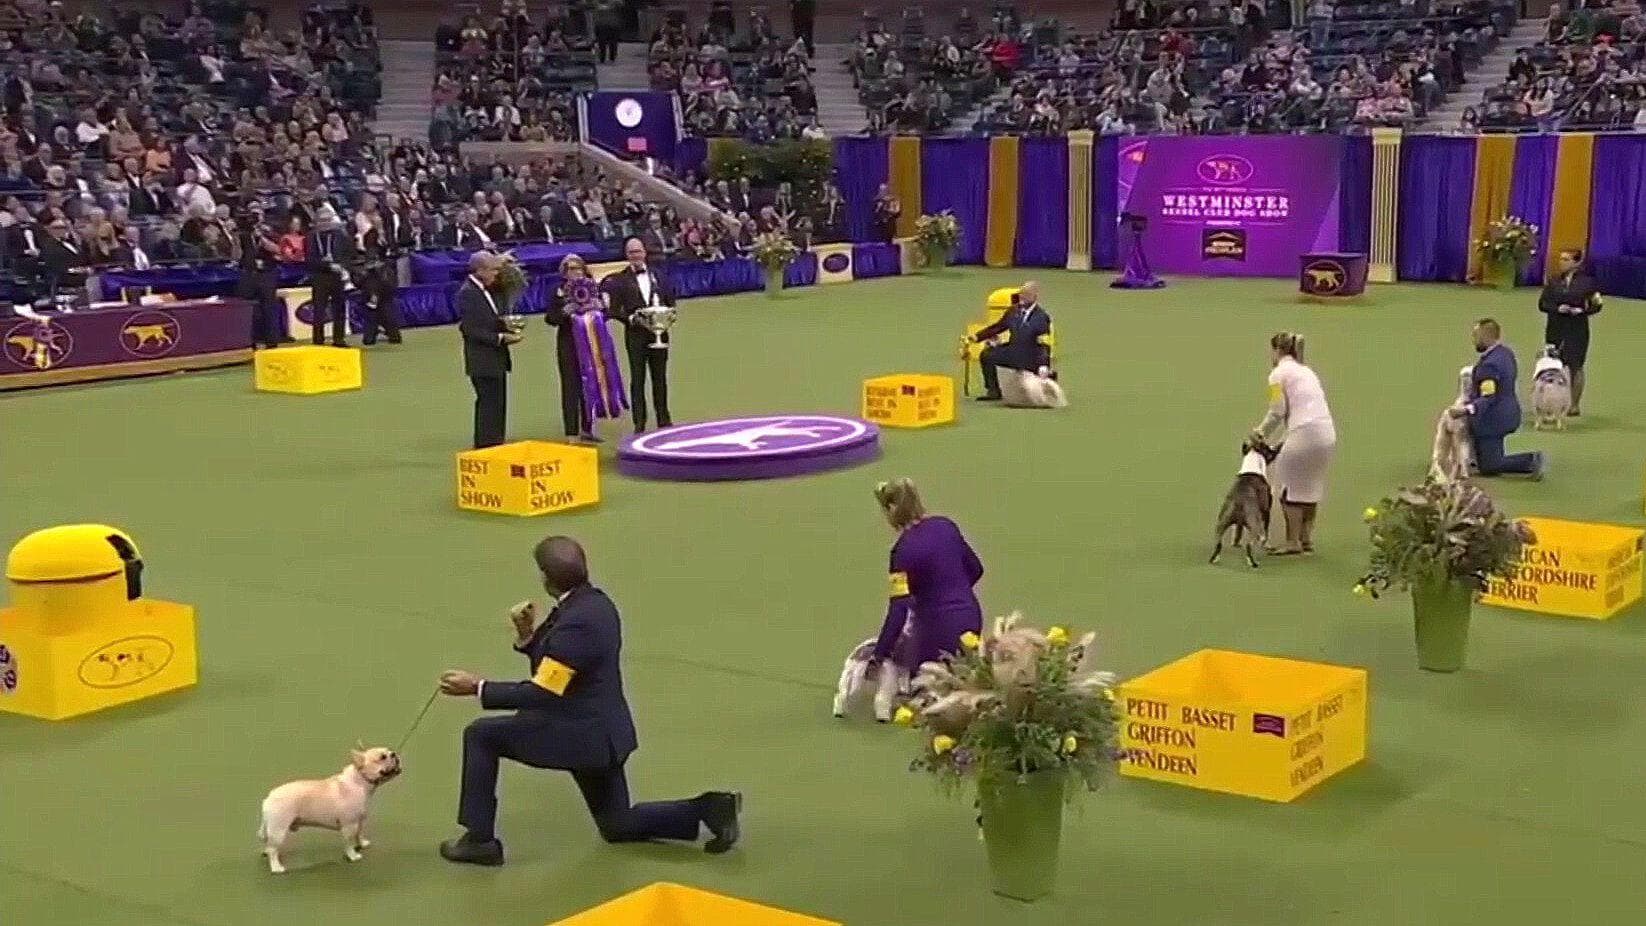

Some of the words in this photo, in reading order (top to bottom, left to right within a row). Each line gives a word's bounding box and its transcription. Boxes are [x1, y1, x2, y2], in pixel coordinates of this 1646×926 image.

[1162, 195, 1289, 210] WESTMINSTER
[459, 458, 489, 474] BEST
[530, 459, 561, 478] BEST
[461, 474, 476, 488] IN
[530, 479, 547, 494] IN
[460, 490, 502, 508] SHOW
[530, 490, 574, 509] SHOW
[1522, 547, 1562, 567] ICAN
[1490, 580, 1539, 605] ERRIER
[1127, 698, 1168, 721] PETIT
[1182, 706, 1238, 732] BASSET
[1128, 721, 1196, 749] GRIFFON
[1127, 747, 1197, 775] VENDEEN
